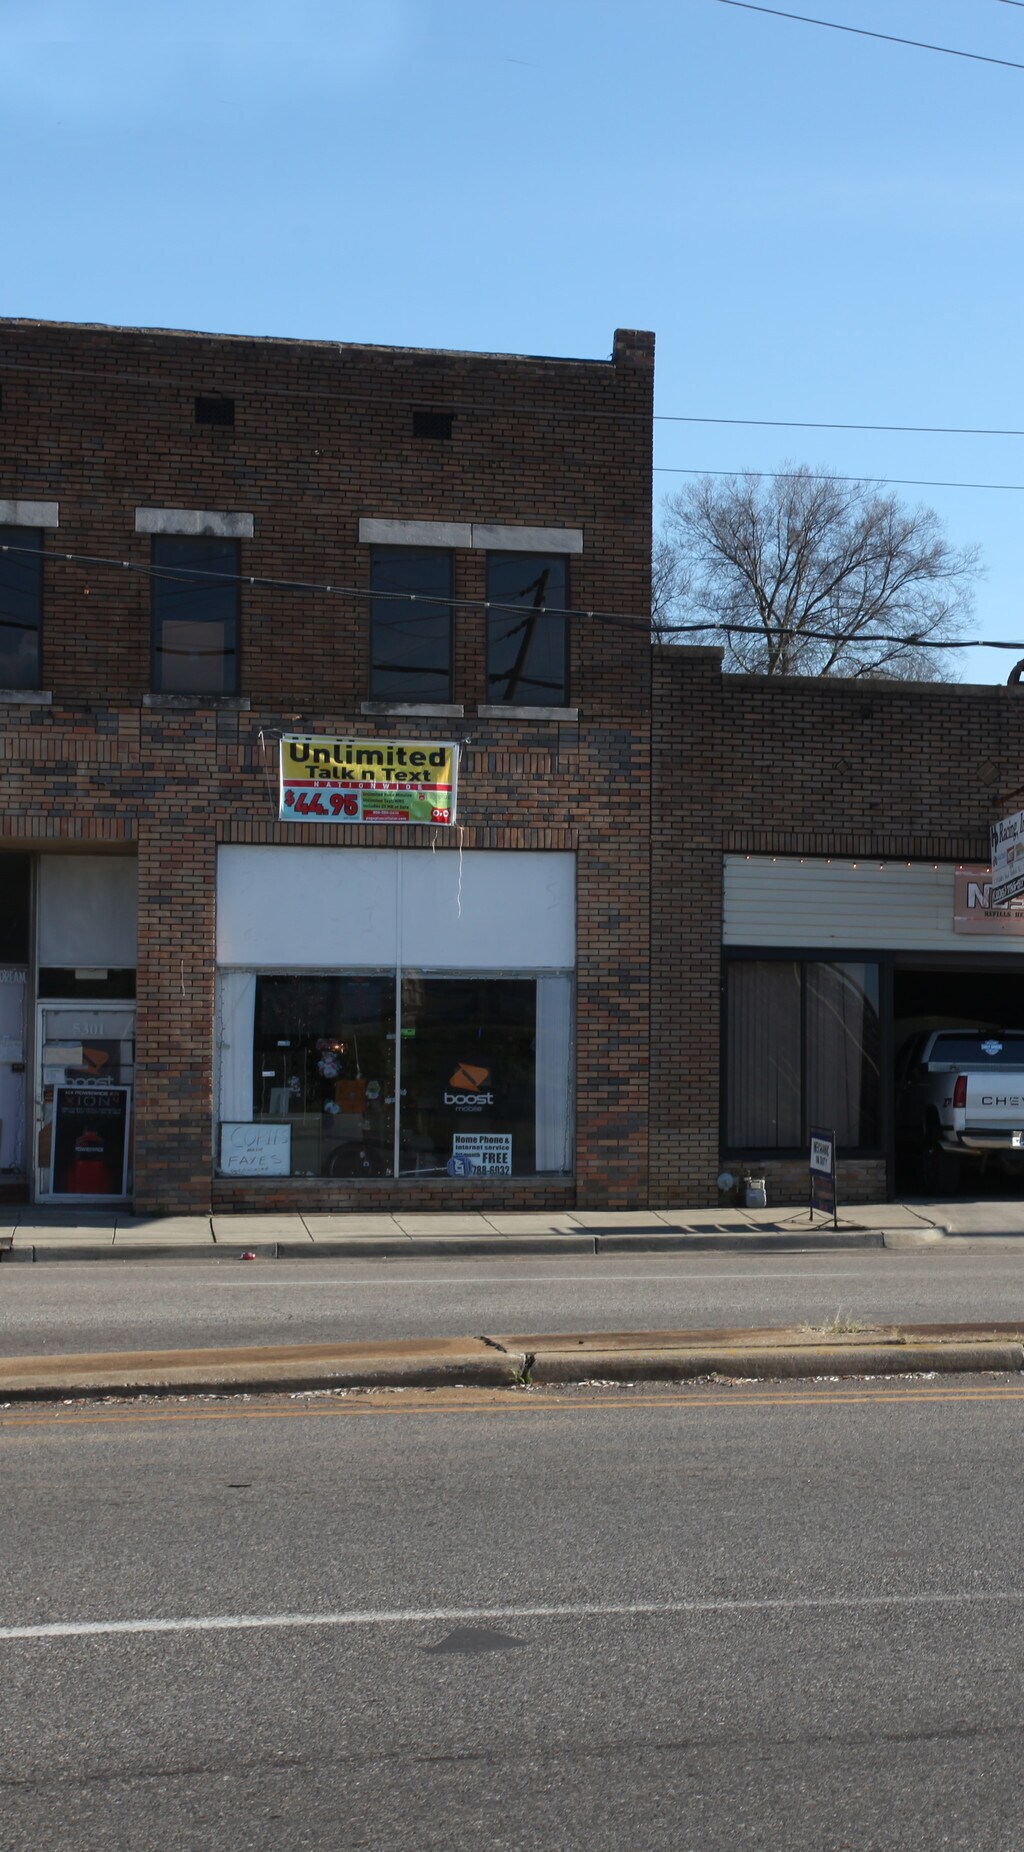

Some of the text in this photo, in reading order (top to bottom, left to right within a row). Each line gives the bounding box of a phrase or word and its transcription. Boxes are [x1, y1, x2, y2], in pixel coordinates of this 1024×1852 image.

[289, 743, 446, 767] Unlimited
[305, 765, 431, 782] Talk n Text
[313, 781, 423, 791] NATIONWIDE
[284, 788, 359, 816] $44.95
[984, 910, 1011, 918] REFILLS
[73, 1023, 105, 1036] 5301
[444, 1091, 494, 1105] boost
[455, 1135, 478, 1144] Home
[479, 1135, 503, 1144] Phone
[482, 1152, 508, 1164] FREE
